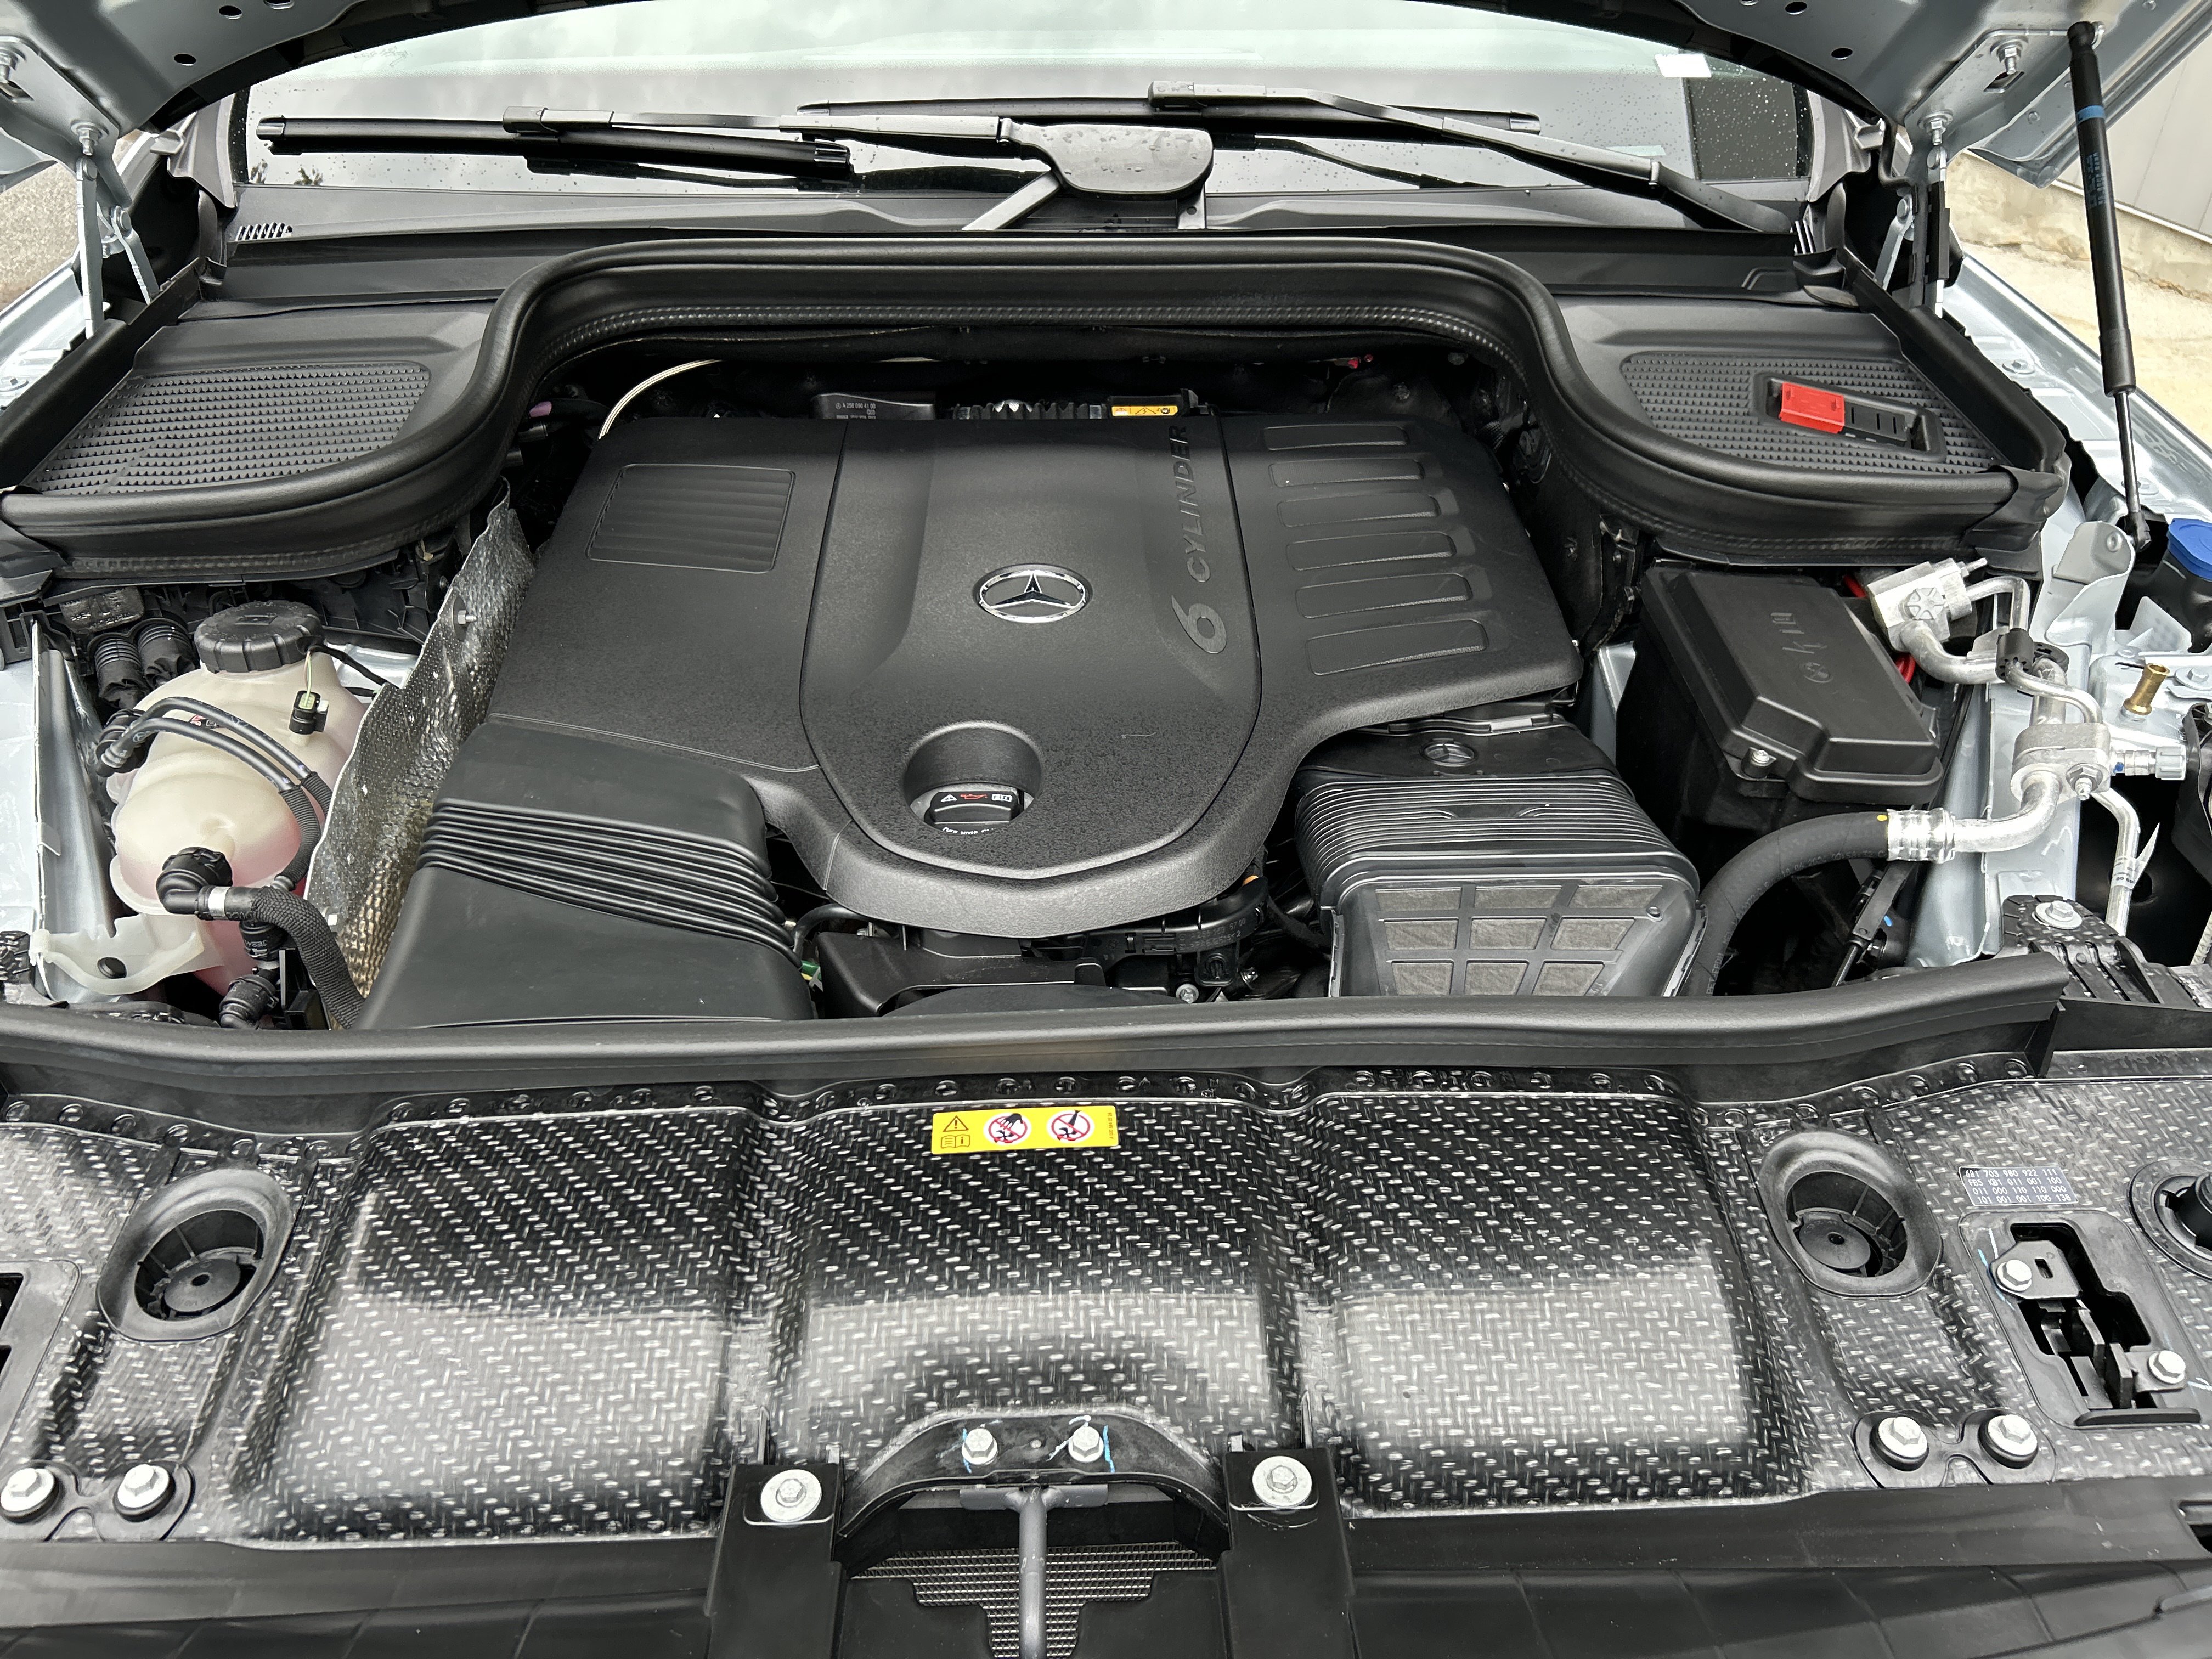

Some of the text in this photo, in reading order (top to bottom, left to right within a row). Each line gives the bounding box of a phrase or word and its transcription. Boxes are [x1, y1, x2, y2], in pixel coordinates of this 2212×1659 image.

[1168, 425, 1227, 654] 6 CYLINDER
[1965, 1170, 1979, 1178] 681
[1983, 1170, 1999, 1178] 703
[2022, 1169, 2038, 1177] 922
[1992, 1187, 2008, 1195] 000
[2012, 1186, 2028, 1194] 110
[2032, 1186, 2047, 1194] 110
[2050, 1185, 2067, 1193] 000
[1977, 1196, 1993, 1204] 101
[1996, 1195, 2012, 1204] 001
[2016, 1195, 2032, 1203] 001
[2036, 1194, 2052, 1203] 100
